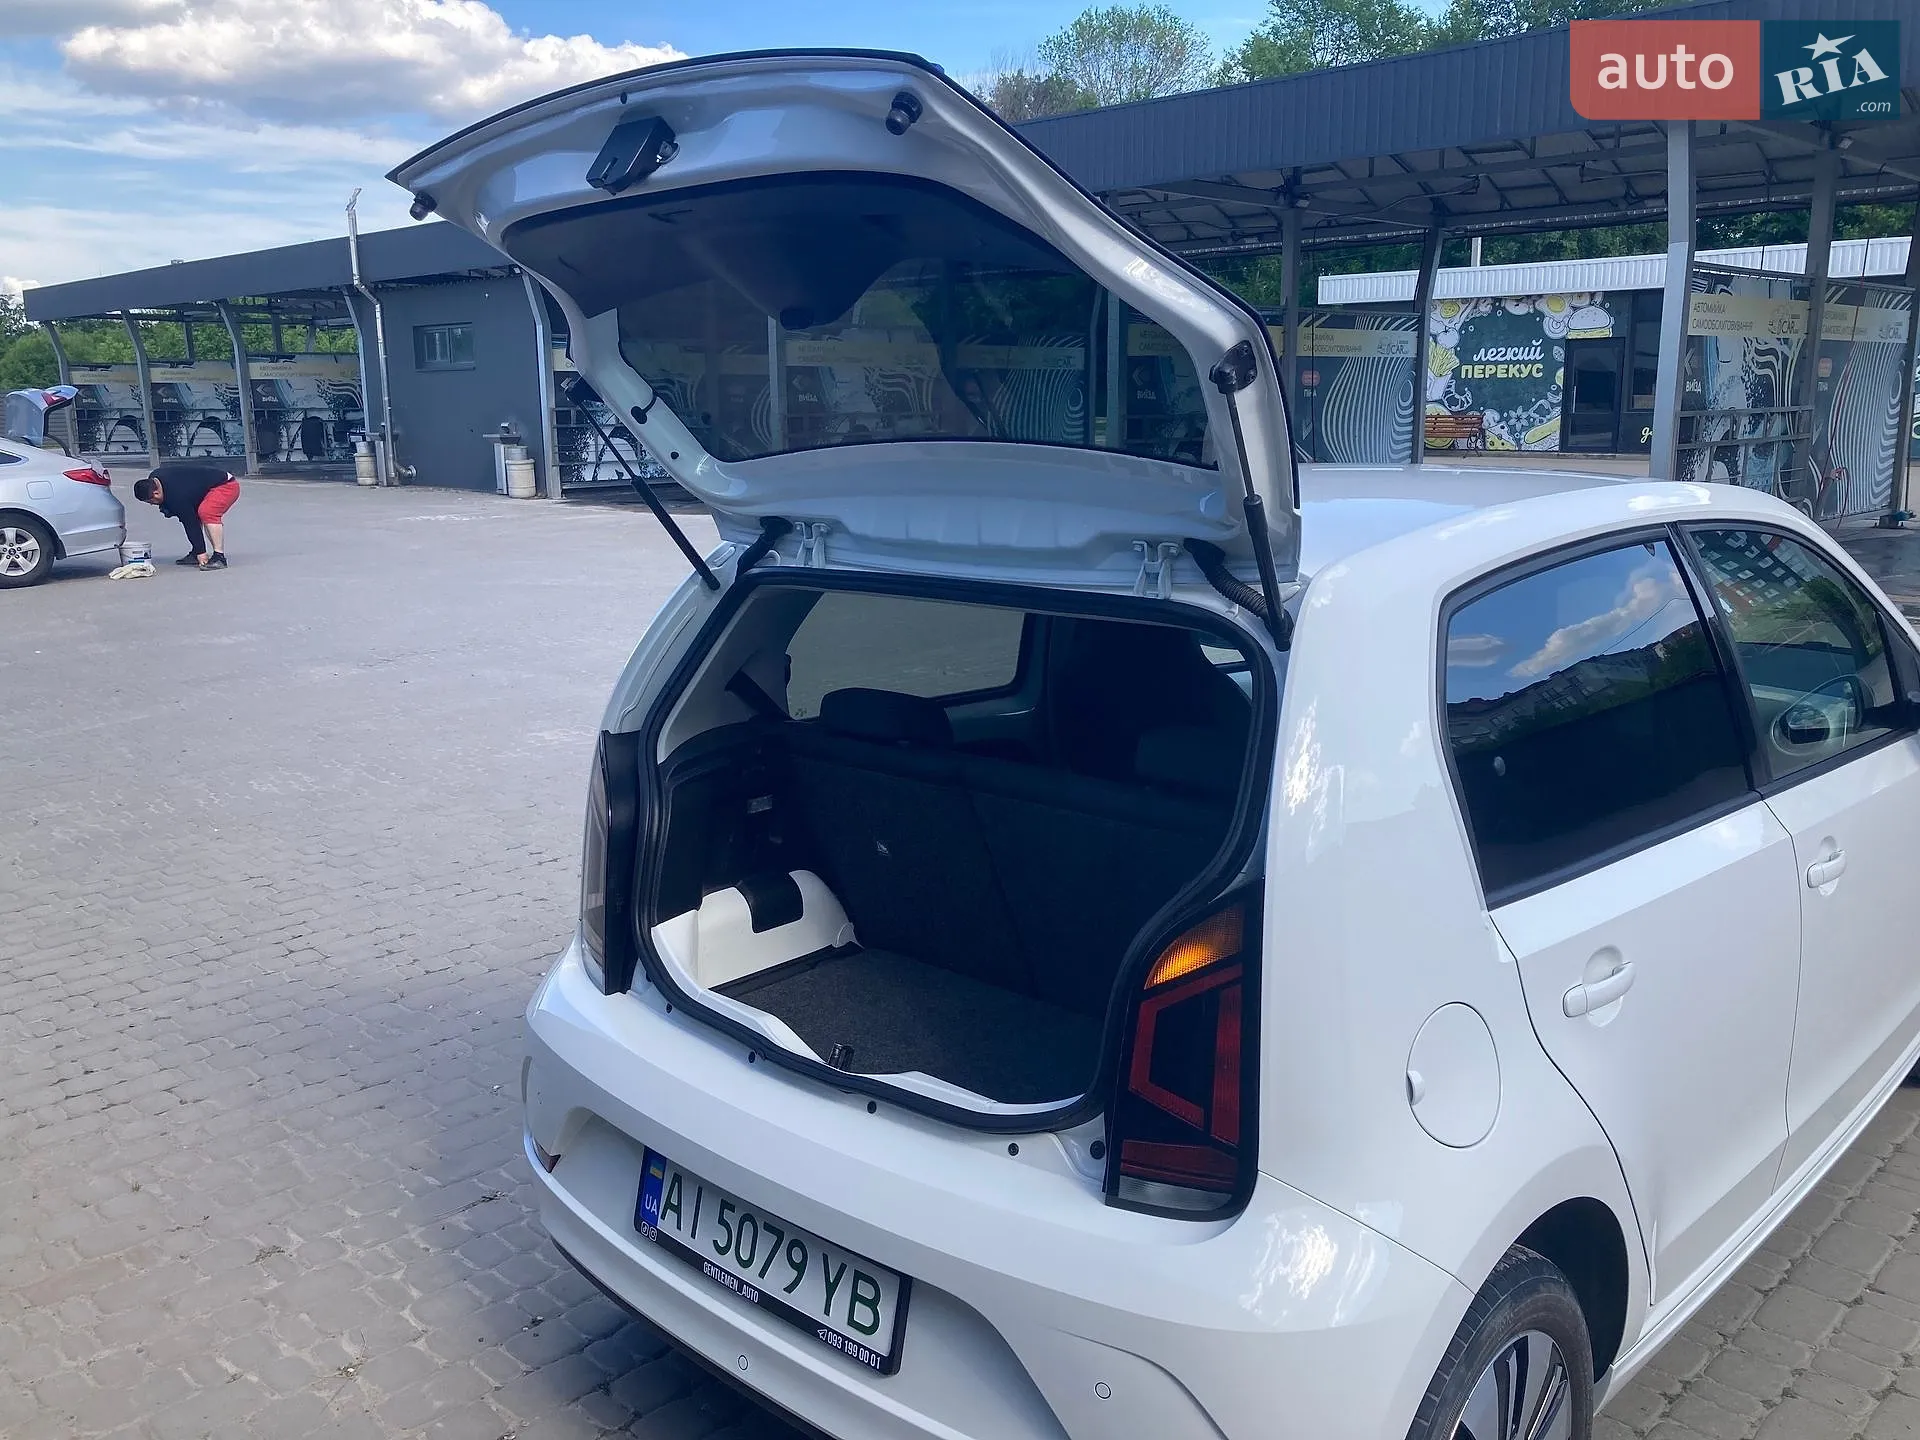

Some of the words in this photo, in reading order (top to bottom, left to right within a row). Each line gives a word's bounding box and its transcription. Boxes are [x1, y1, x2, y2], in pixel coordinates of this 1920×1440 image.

[1461, 363, 1544, 379] ПЕРЕКУС
[644, 1193, 658, 1216] UA
[660, 1172, 703, 1240] AI
[713, 1198, 809, 1295] 5079
[822, 1252, 882, 1336] YB
[703, 1261, 759, 1304] GENTLEMEN_AUTO
[827, 1331, 843, 1349] 093
[844, 1341, 858, 1357] 199
[858, 1348, 870, 1364] 00
[870, 1353, 881, 1370] 01
